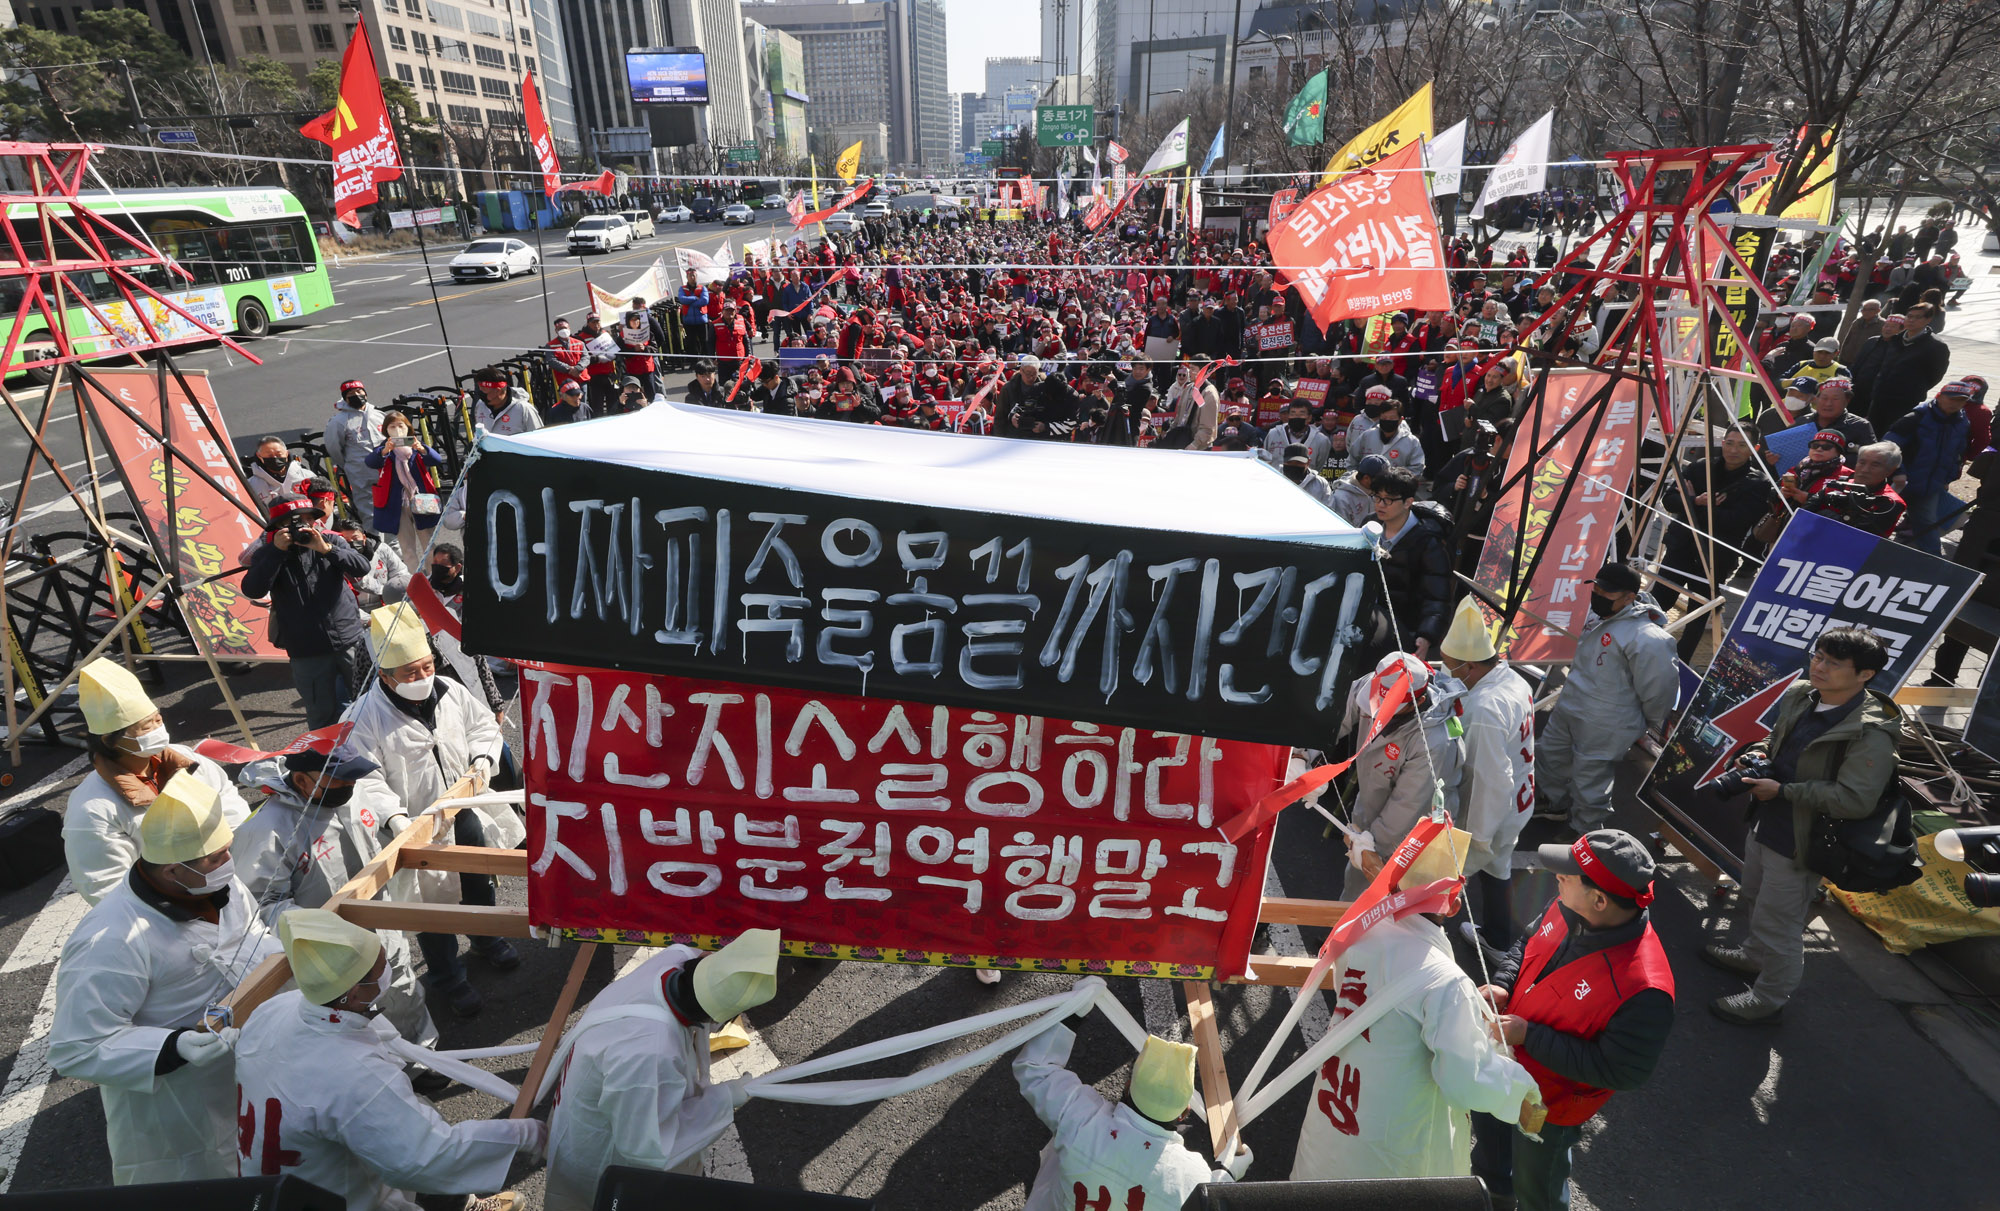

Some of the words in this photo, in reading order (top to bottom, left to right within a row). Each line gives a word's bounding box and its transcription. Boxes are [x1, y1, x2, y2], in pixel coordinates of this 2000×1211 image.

[1042, 110, 1087, 122] 종로1가
[1041, 123, 1060, 131] Jongno
[226, 267, 251, 282] 7011
[1260, 323, 1291, 336] 송전선로
[1261, 333, 1292, 349] 완전무효
[1774, 558, 1950, 624] 기울어진
[1539, 920, 1554, 937] 투
[1574, 978, 1592, 1001] 쟁
